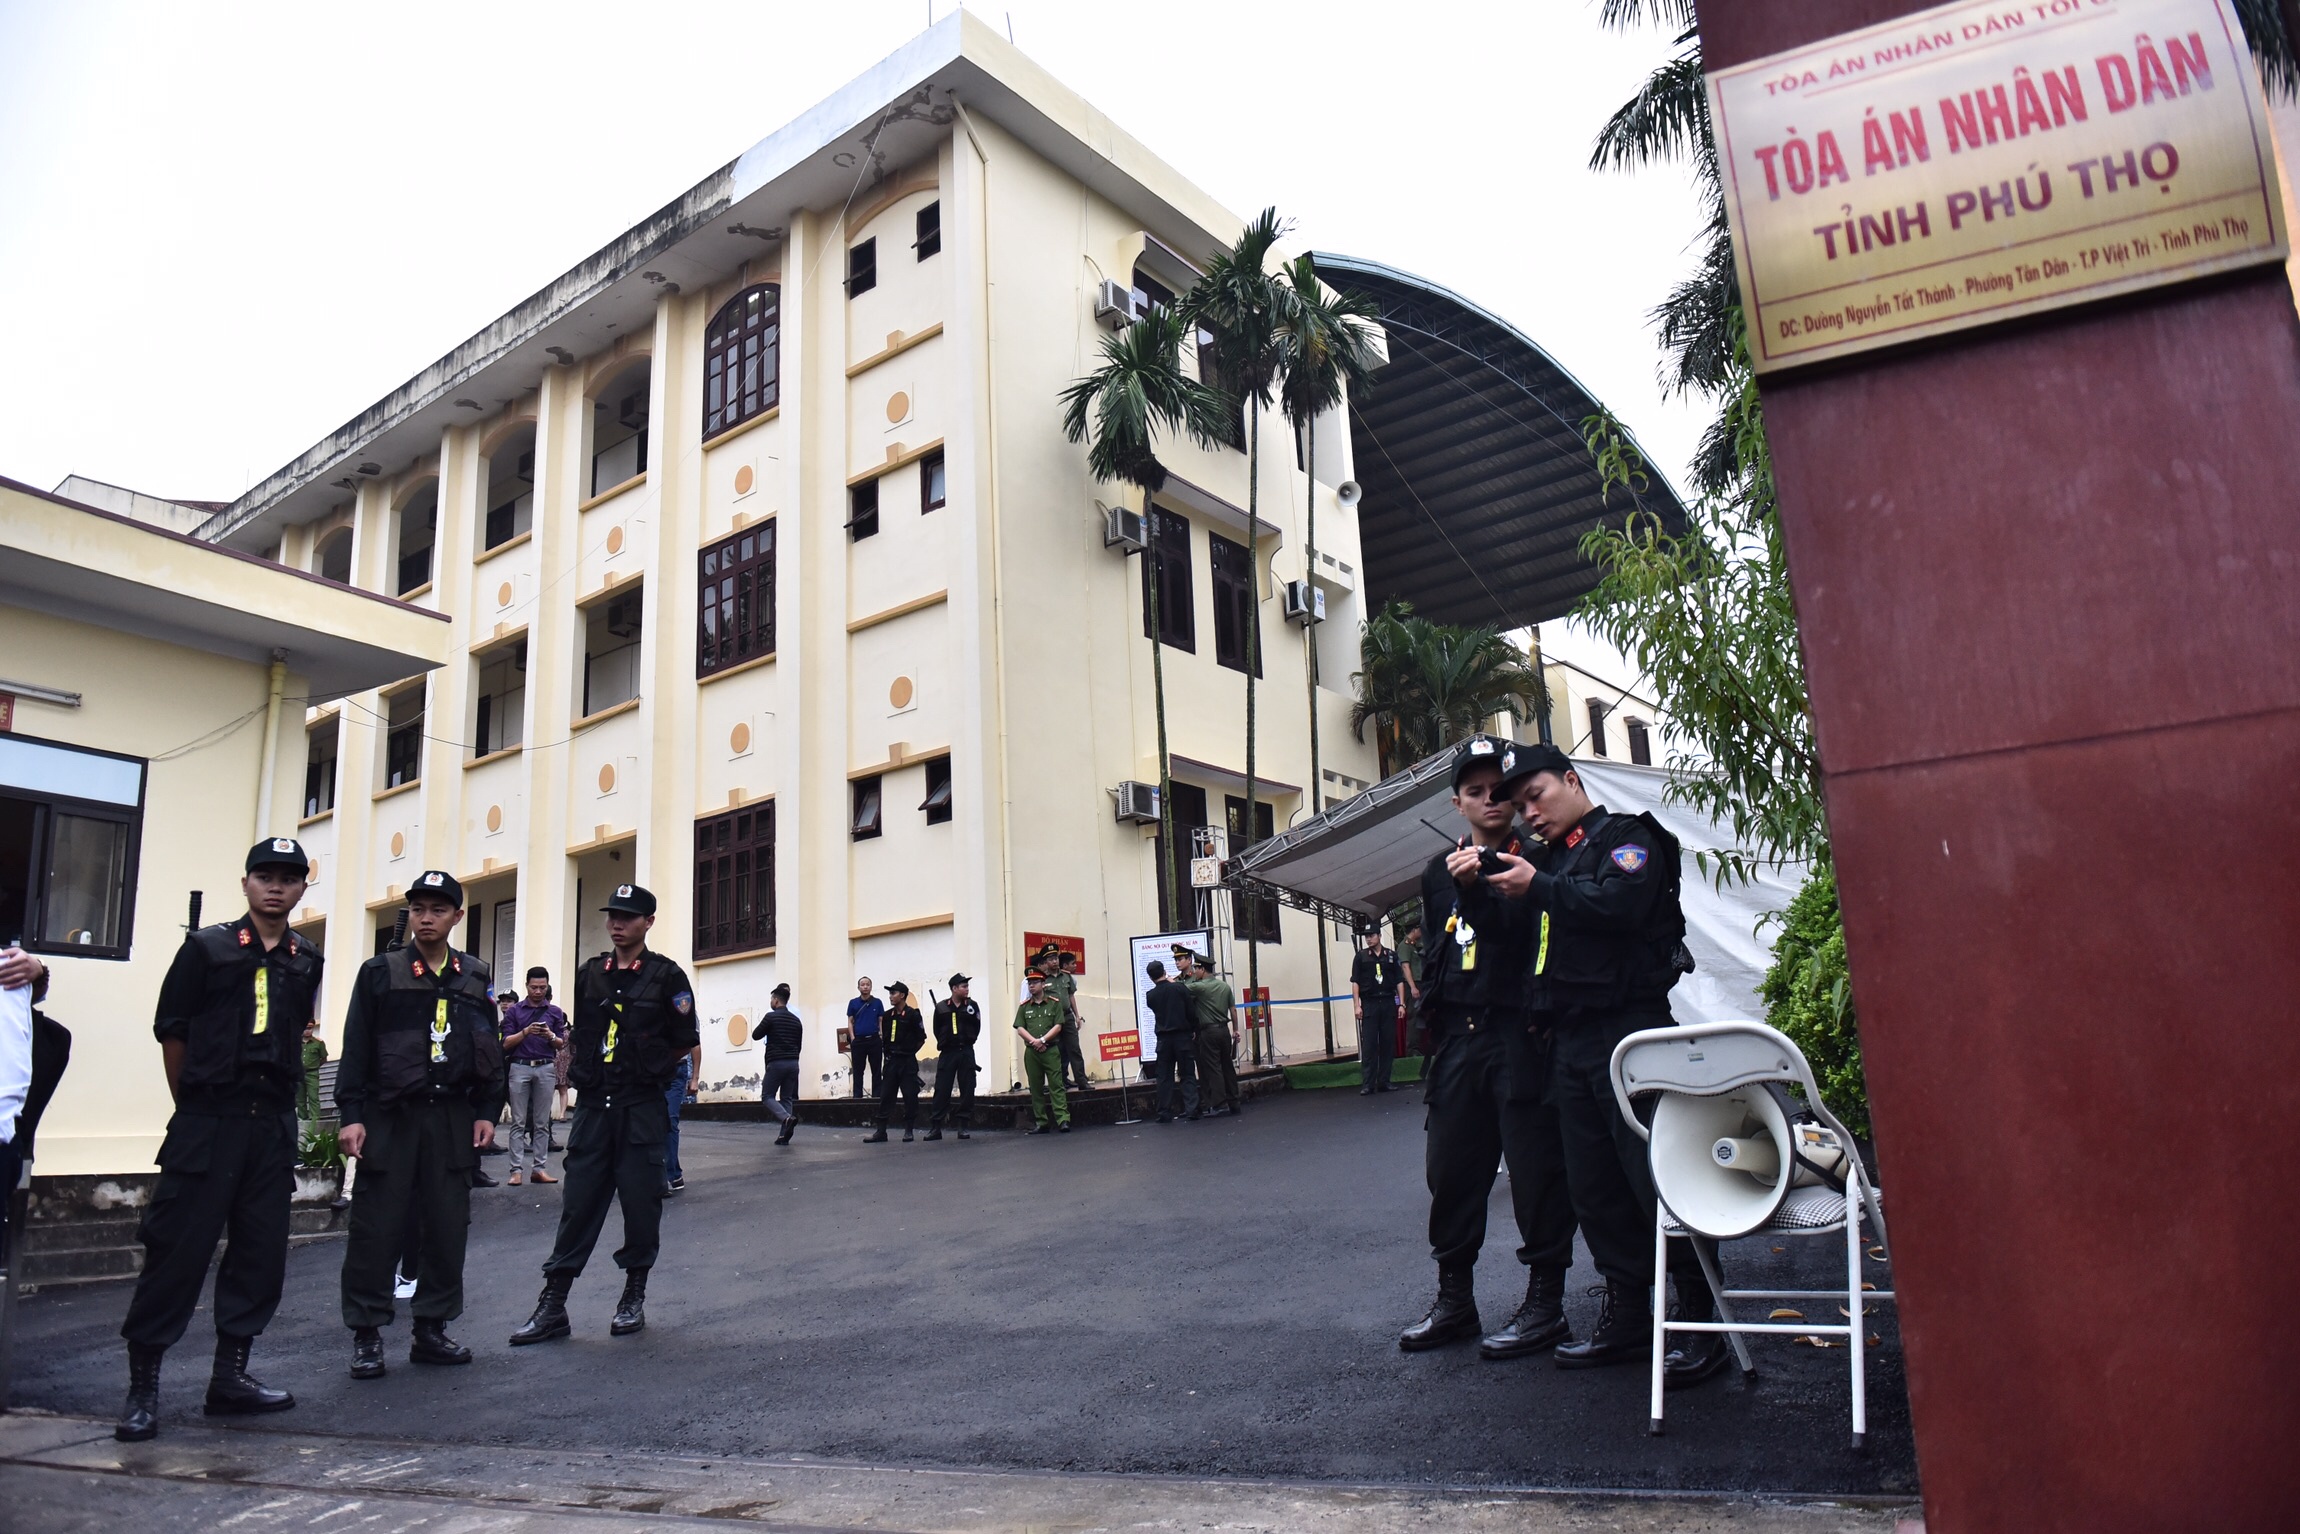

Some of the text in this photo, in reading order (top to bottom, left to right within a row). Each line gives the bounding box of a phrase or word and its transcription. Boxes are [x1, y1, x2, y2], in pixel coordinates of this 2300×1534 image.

[1763, 72, 1819, 96] TÒA
[1828, 58, 1867, 79] ÁN
[1875, 30, 1955, 65] NHÂN
[1962, 9, 2025, 41] DÂN
[1753, 29, 2215, 202] TÒA ÁN NHÂN DÂN
[1813, 141, 2180, 261] TỈNH PHÚ THỌ
